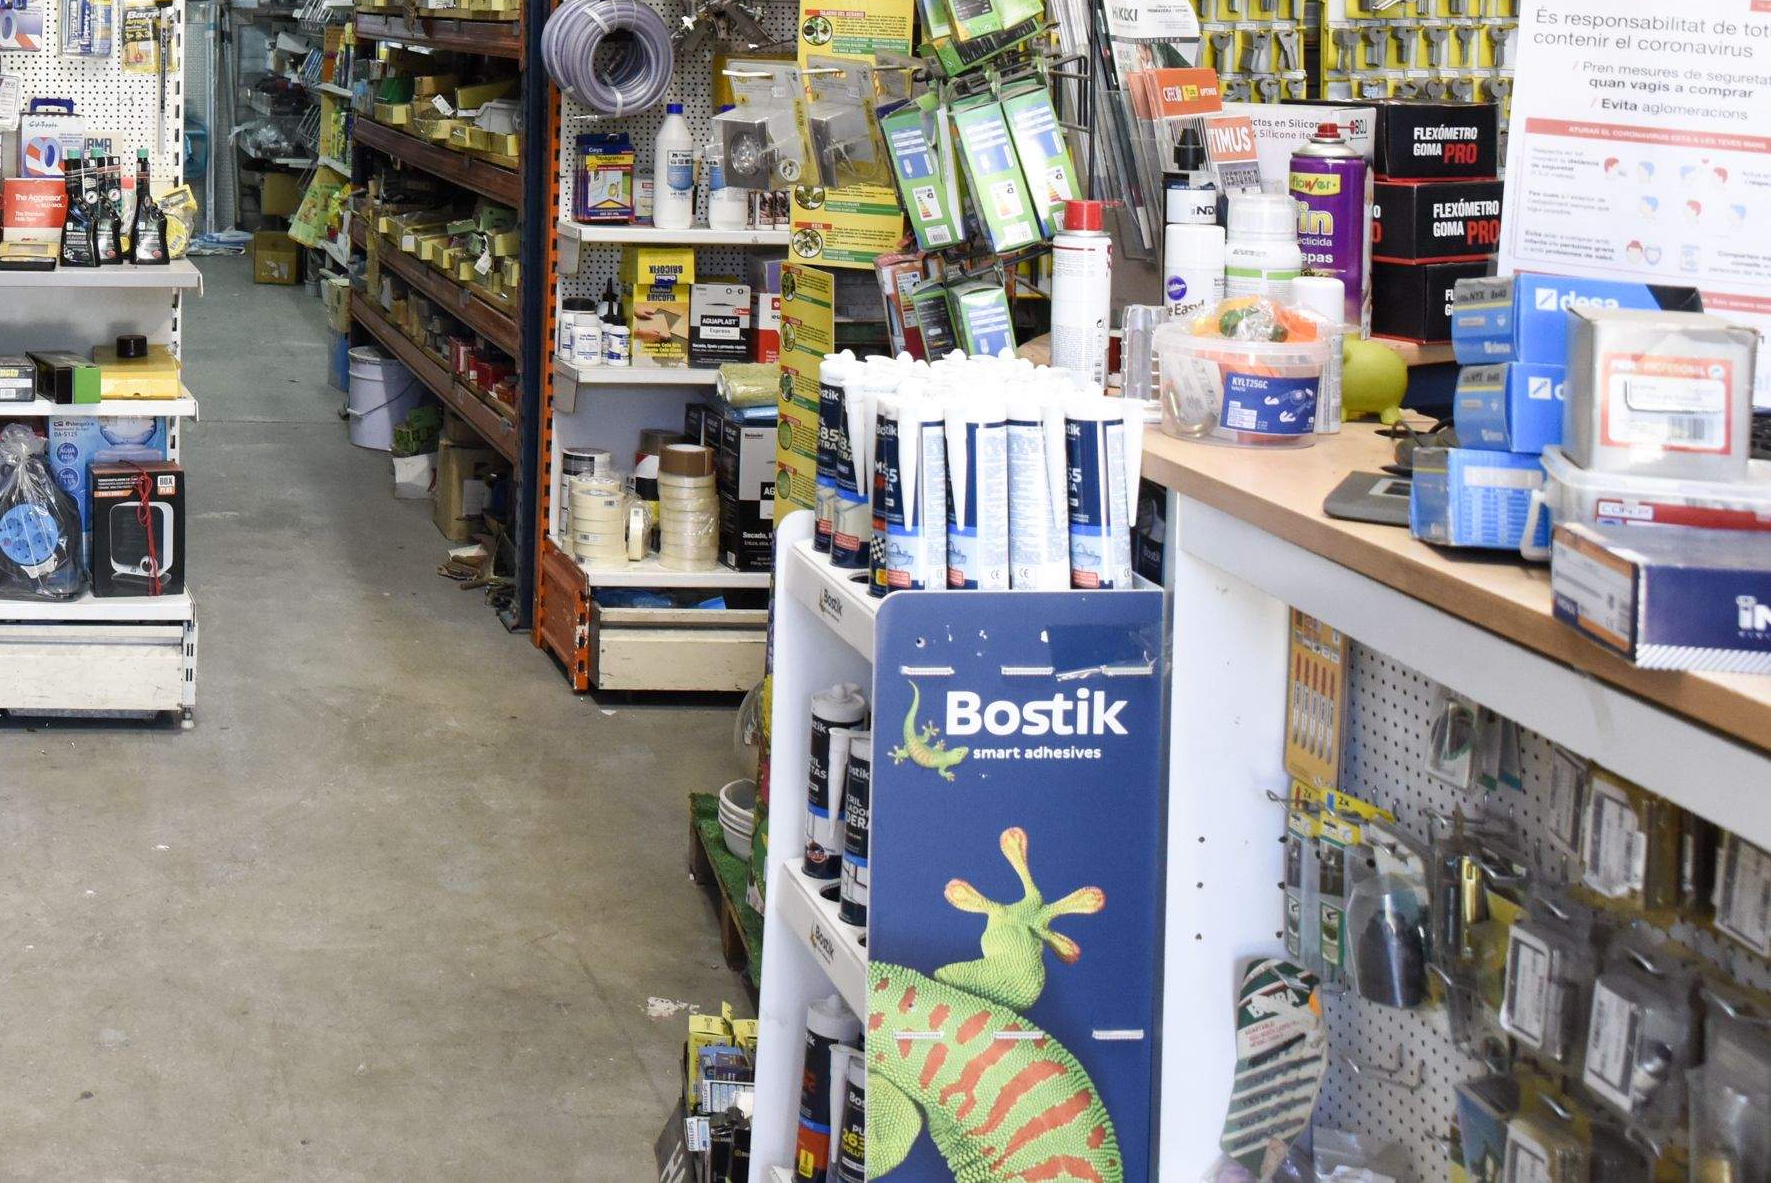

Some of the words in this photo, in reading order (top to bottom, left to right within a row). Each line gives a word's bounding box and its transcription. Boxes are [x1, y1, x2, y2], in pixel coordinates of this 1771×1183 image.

[1536, 5, 1559, 25] És
[1564, 12, 1706, 34] responsabilitat
[1713, 19, 1738, 36] de
[1744, 23, 1771, 39] tot
[1532, 29, 1610, 49] contenir
[1614, 36, 1632, 50] el
[1637, 37, 1755, 59] coronavirus
[1582, 61, 1615, 75] Pren
[1618, 65, 1680, 79] mesures
[1683, 68, 1703, 81] de
[1589, 77, 1626, 90] quan
[1630, 79, 1671, 93] vagis
[1674, 84, 1684, 93] a
[1688, 84, 1755, 100] comprar
[1601, 97, 1639, 112] Evita
[1641, 101, 1748, 121] aglomeracions
[1274, 120, 1287, 128] en
[1288, 118, 1324, 129] Silicon
[1413, 124, 1478, 141] FLEXÓMETRO
[1260, 130, 1298, 140] Silicone
[1413, 143, 1442, 157] GOMA
[1443, 143, 1478, 165] PRO
[14, 193, 27, 202] The
[28, 193, 62, 203] Aggressor
[1433, 199, 1500, 219] FLEXÓMETRO
[1432, 221, 1465, 238] GOMA
[1466, 220, 1501, 245] PRO
[648, 264, 684, 274] BRICOFIX
[646, 293, 677, 302] BRICOFIX
[701, 317, 739, 326] AGUAPLAST
[945, 687, 1129, 736] Bostik
[972, 746, 1022, 760] smart
[1024, 745, 1102, 760] adhesives
